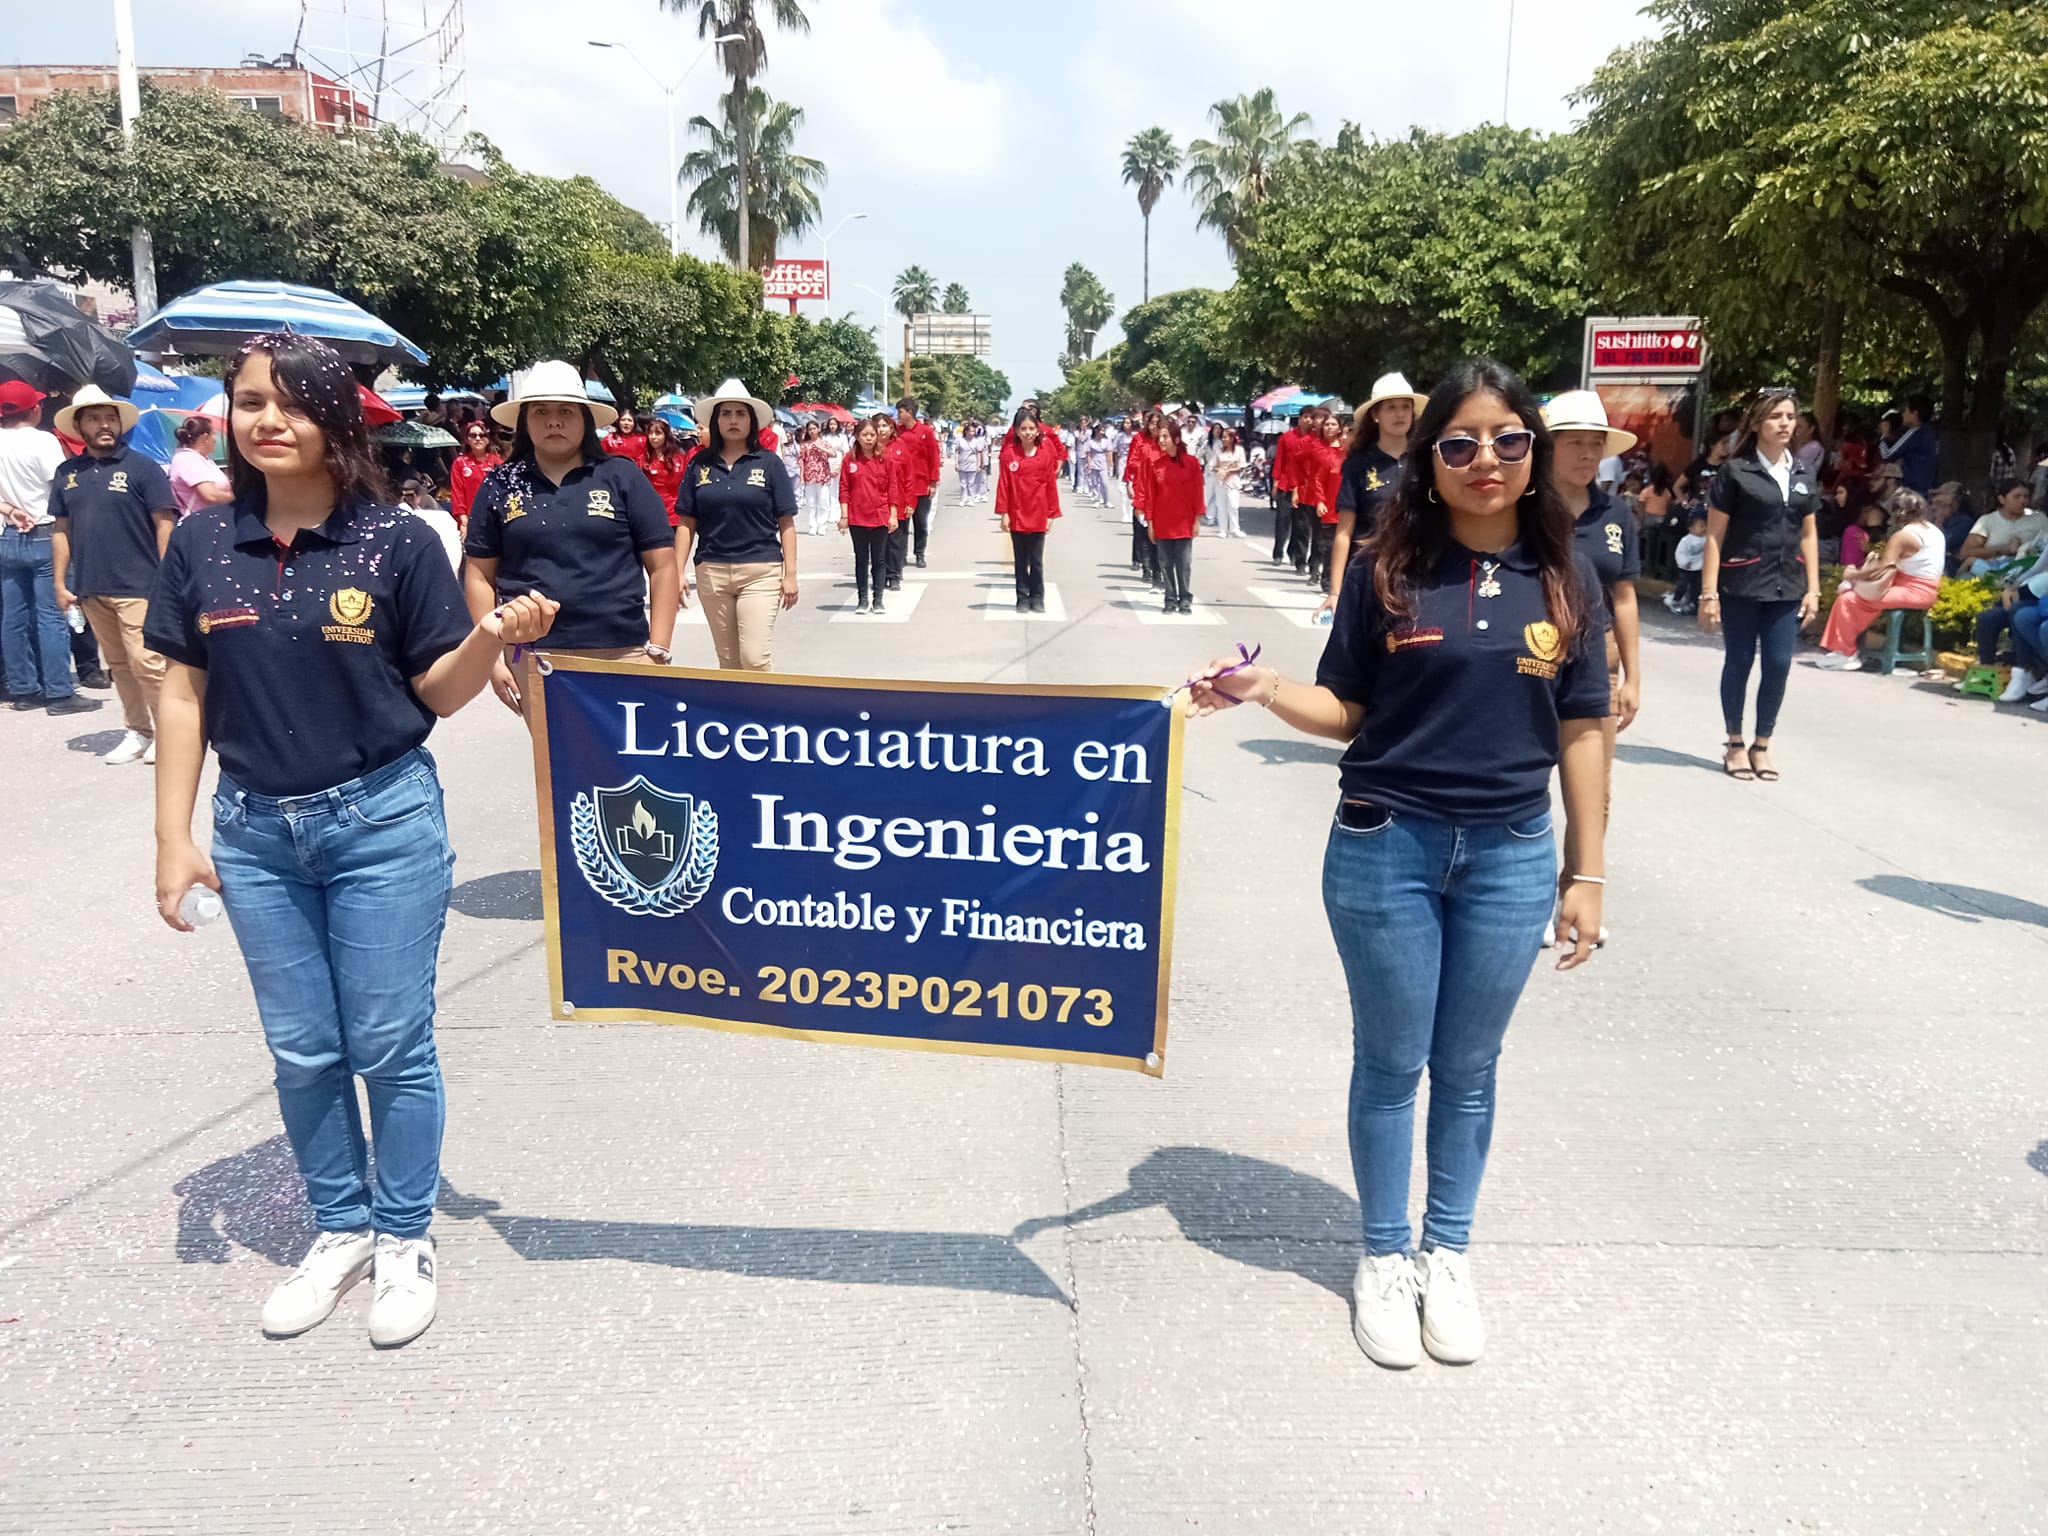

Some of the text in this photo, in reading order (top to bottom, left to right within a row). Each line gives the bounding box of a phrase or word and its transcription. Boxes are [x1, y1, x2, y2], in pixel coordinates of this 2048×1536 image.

[764, 282, 823, 295] DEPOT
[324, 633, 373, 645] EVOLUTION
[617, 701, 1152, 784] Licenciatura en
[751, 793, 1150, 873] Ingenieria
[721, 886, 1147, 951] Contable y Financiera
[606, 949, 1114, 1027] Rvoe. 2023P021073
